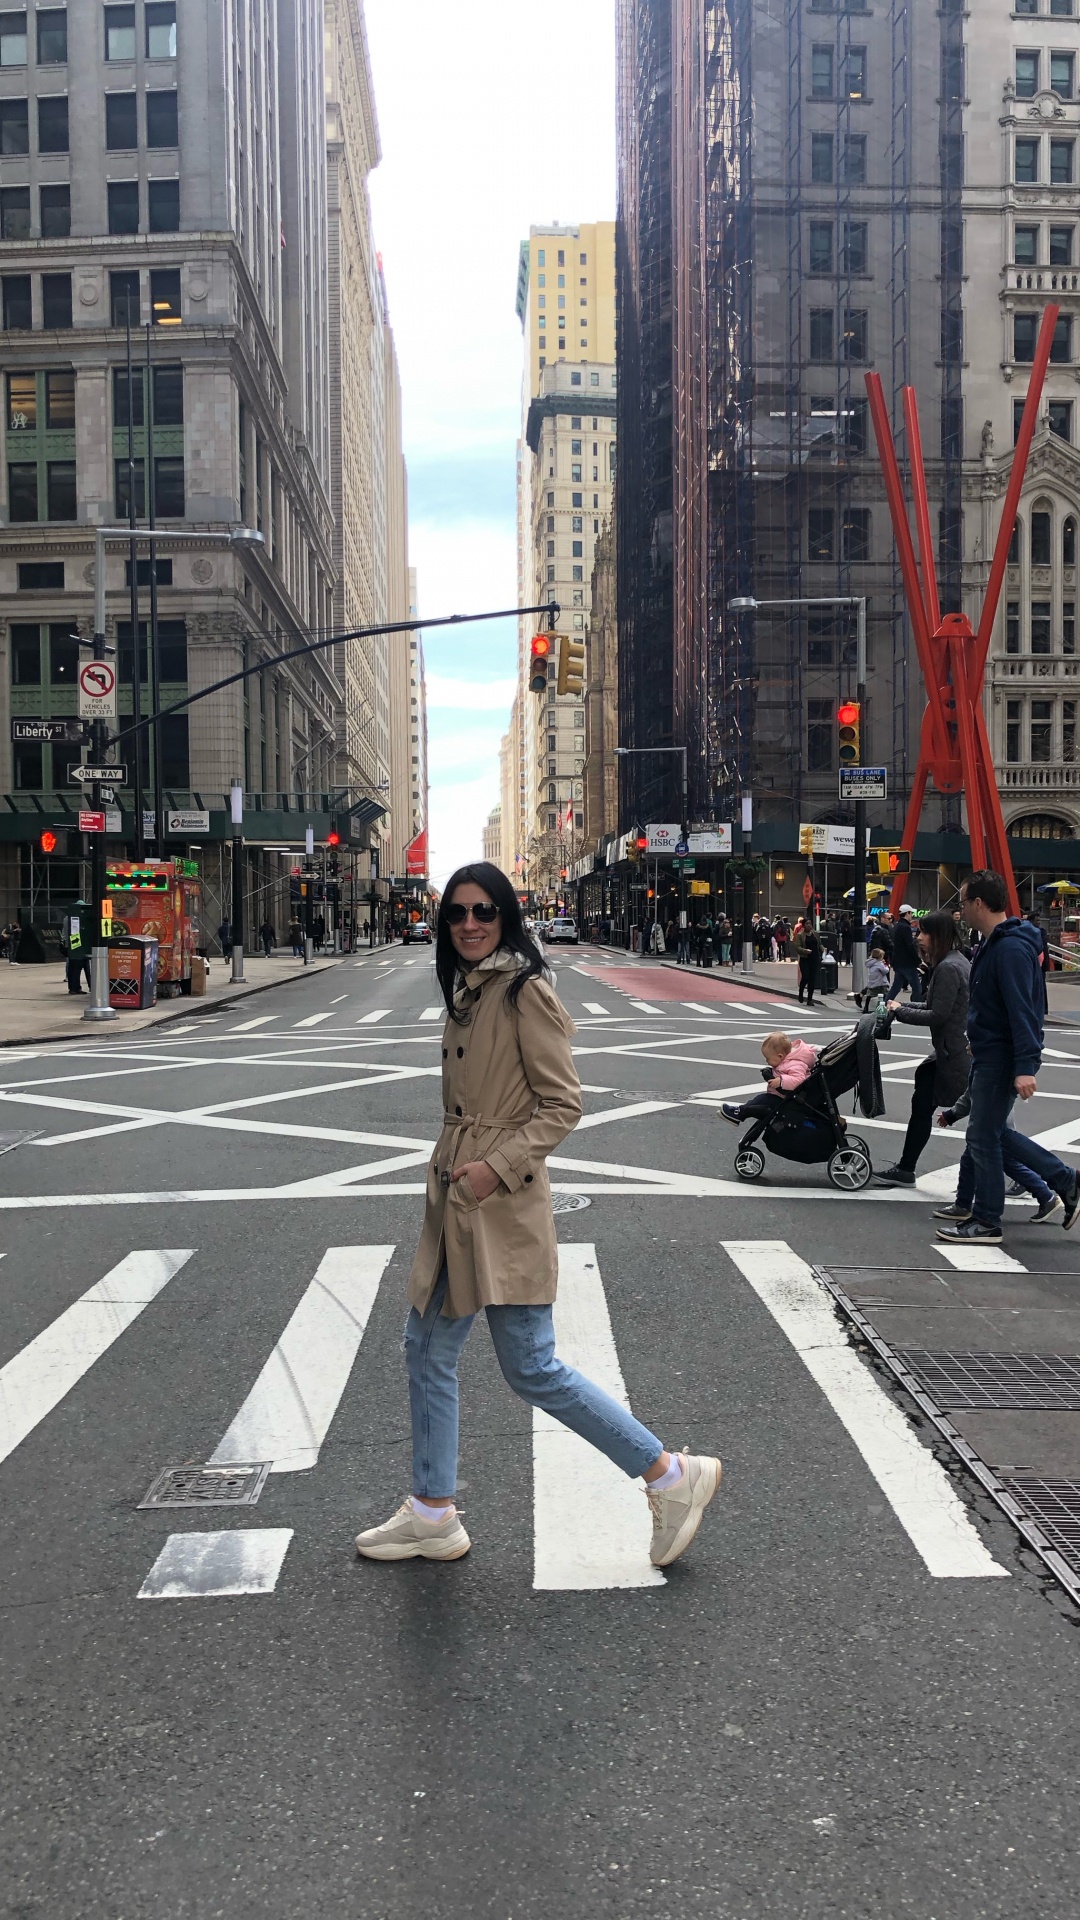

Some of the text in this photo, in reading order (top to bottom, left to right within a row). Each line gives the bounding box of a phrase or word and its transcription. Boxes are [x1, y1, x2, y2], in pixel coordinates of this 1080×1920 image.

[16, 725, 53, 740] Liberty
[79, 770, 119, 778] ONE WAY
[650, 838, 675, 847] HSBC
